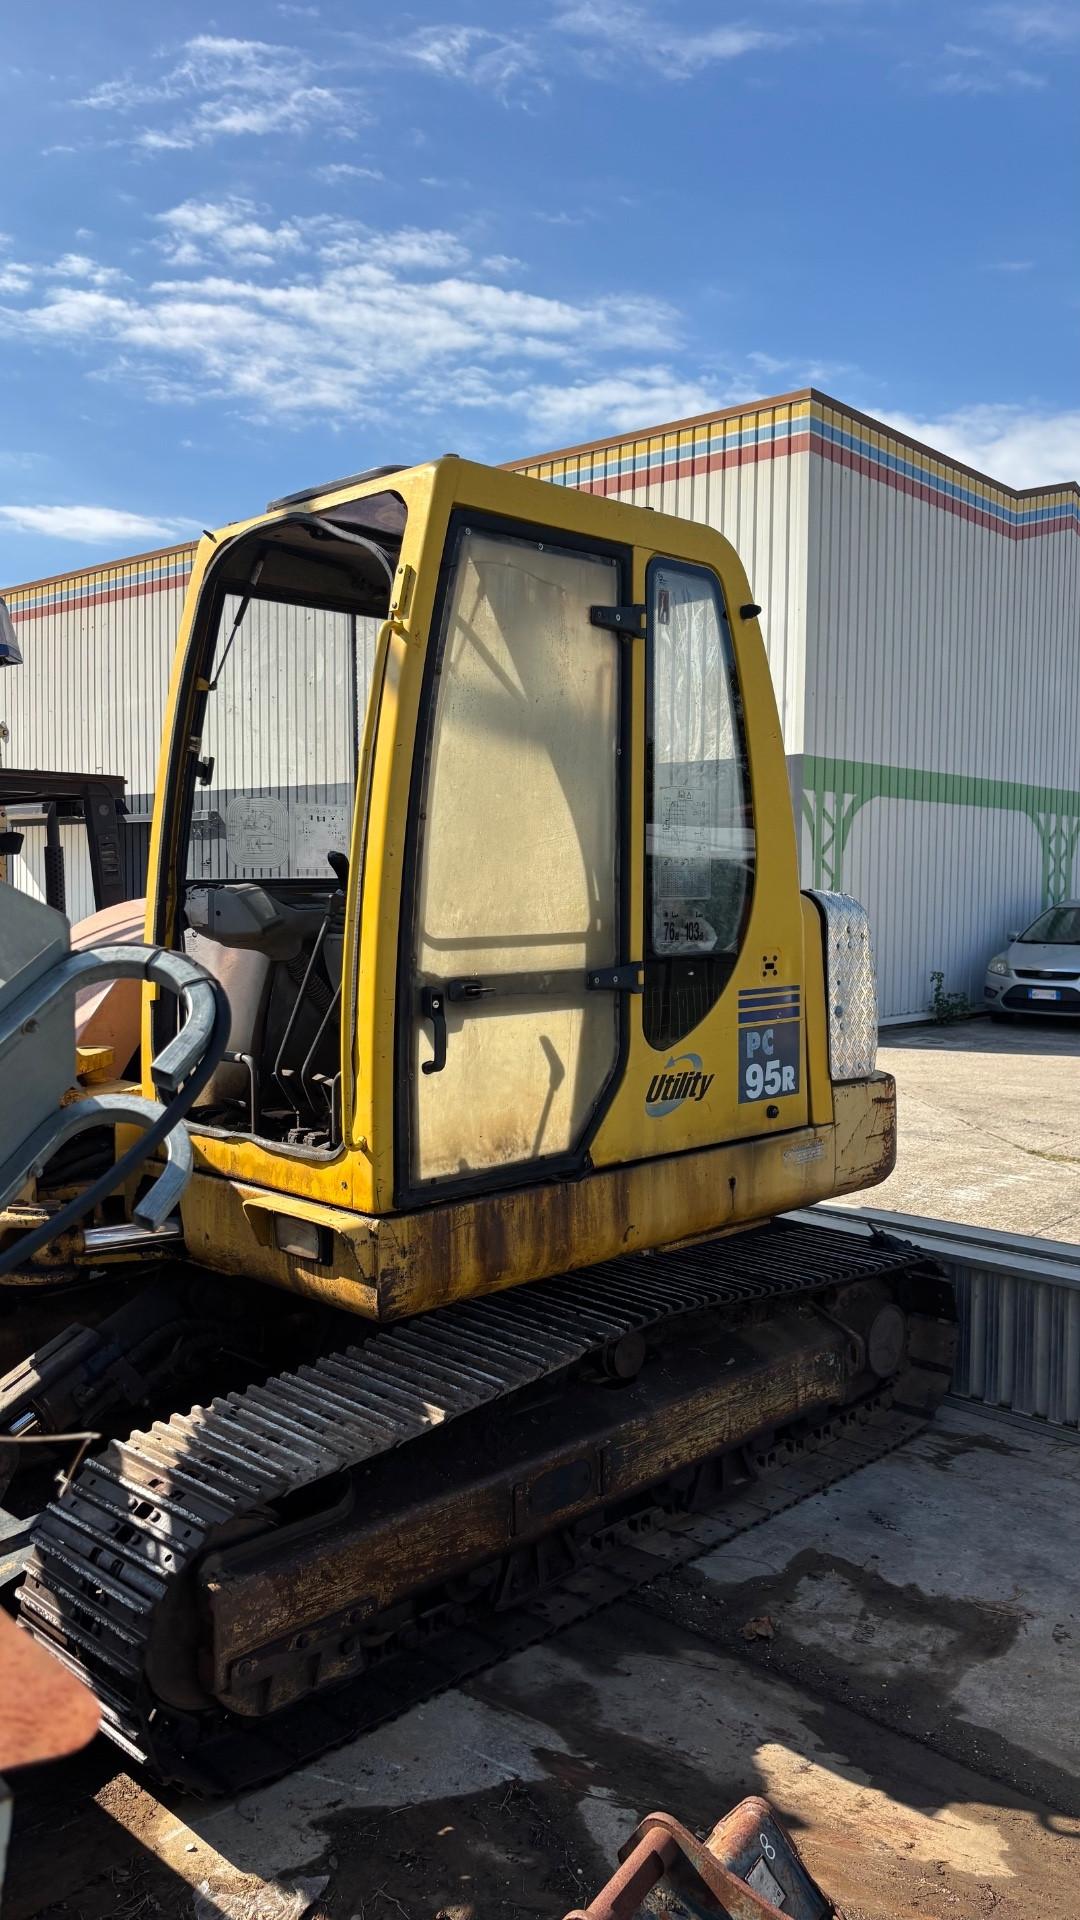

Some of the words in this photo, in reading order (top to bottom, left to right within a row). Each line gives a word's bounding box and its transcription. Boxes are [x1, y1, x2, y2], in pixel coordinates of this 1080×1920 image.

[746, 1028, 774, 1059] PC
[645, 1071, 715, 1103] Utility
[745, 1059, 796, 1099] 95R
